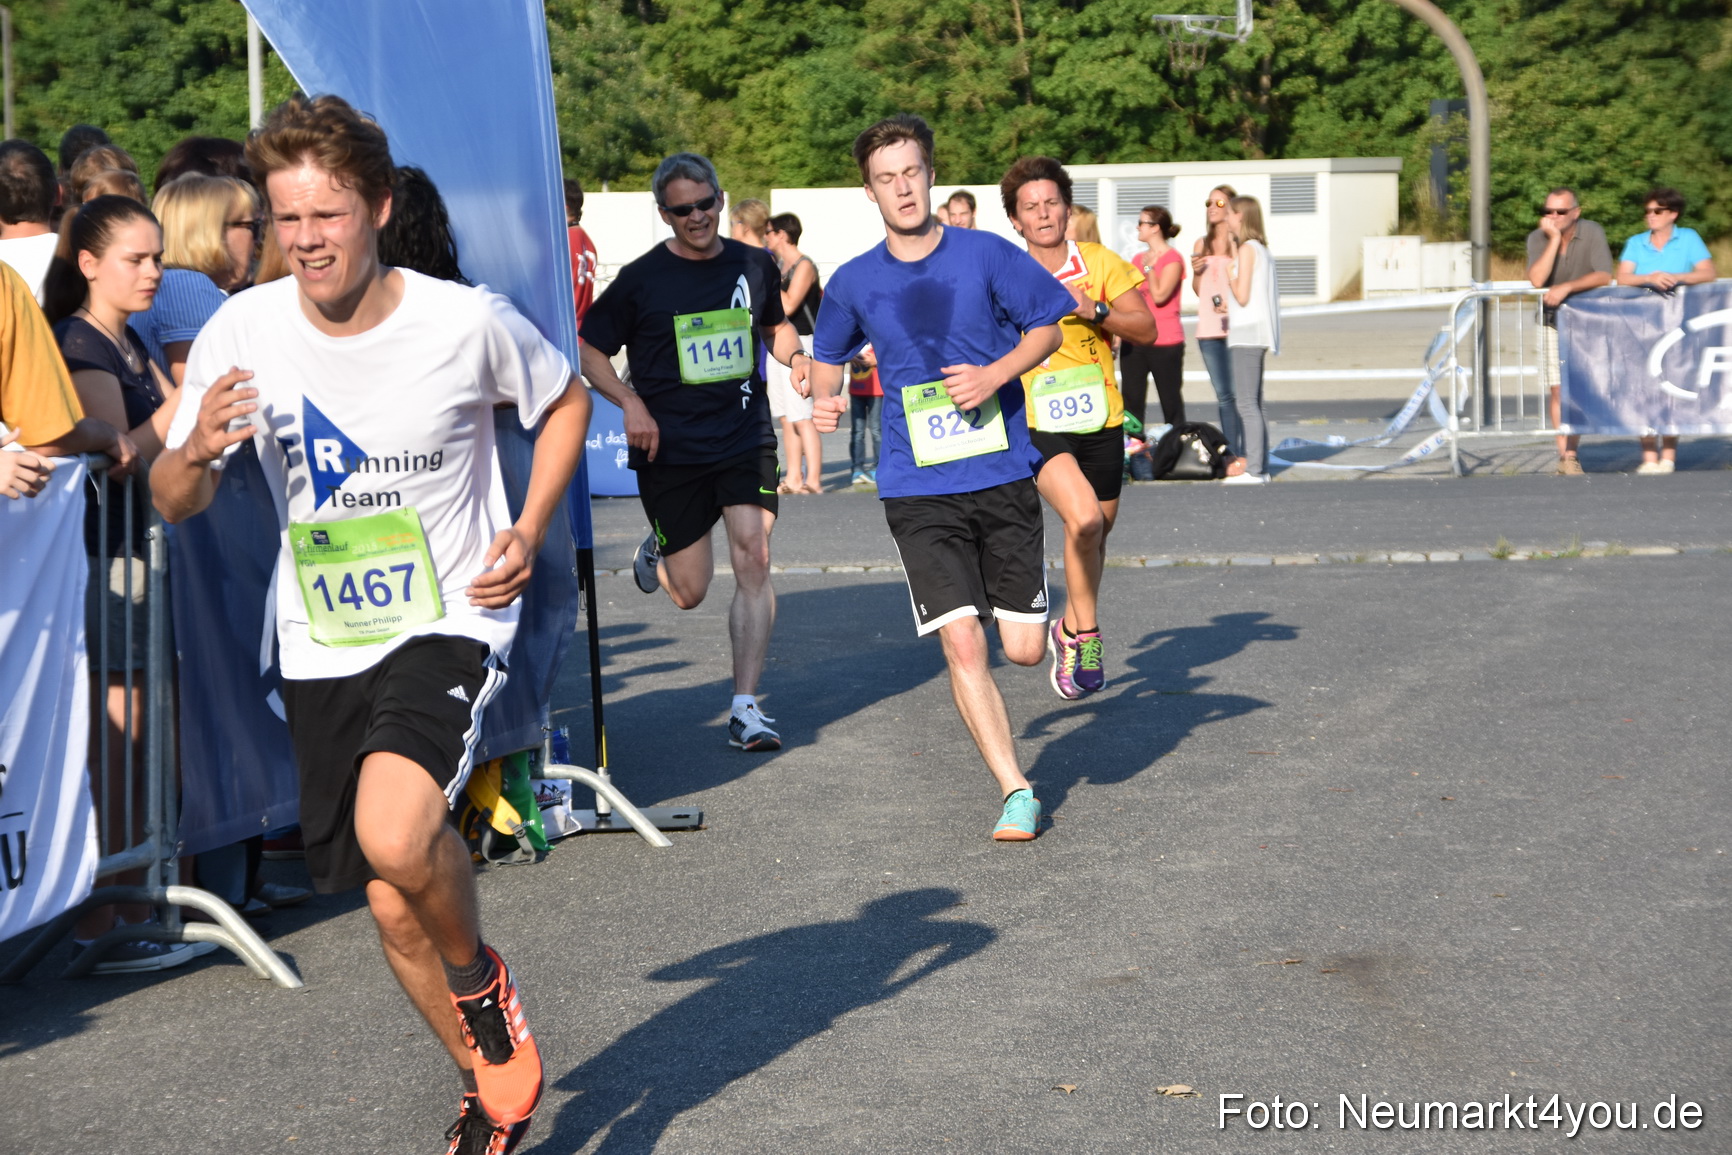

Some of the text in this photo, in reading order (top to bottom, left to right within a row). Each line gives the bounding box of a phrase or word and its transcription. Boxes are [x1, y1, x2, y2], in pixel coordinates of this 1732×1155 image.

[687, 336, 744, 364] 1141
[1048, 393, 1094, 420] 893
[927, 407, 985, 440] 822
[313, 438, 444, 474] Running
[325, 484, 402, 508] Team
[312, 562, 415, 612] 1467
[343, 614, 403, 629] Nunner Philipp
